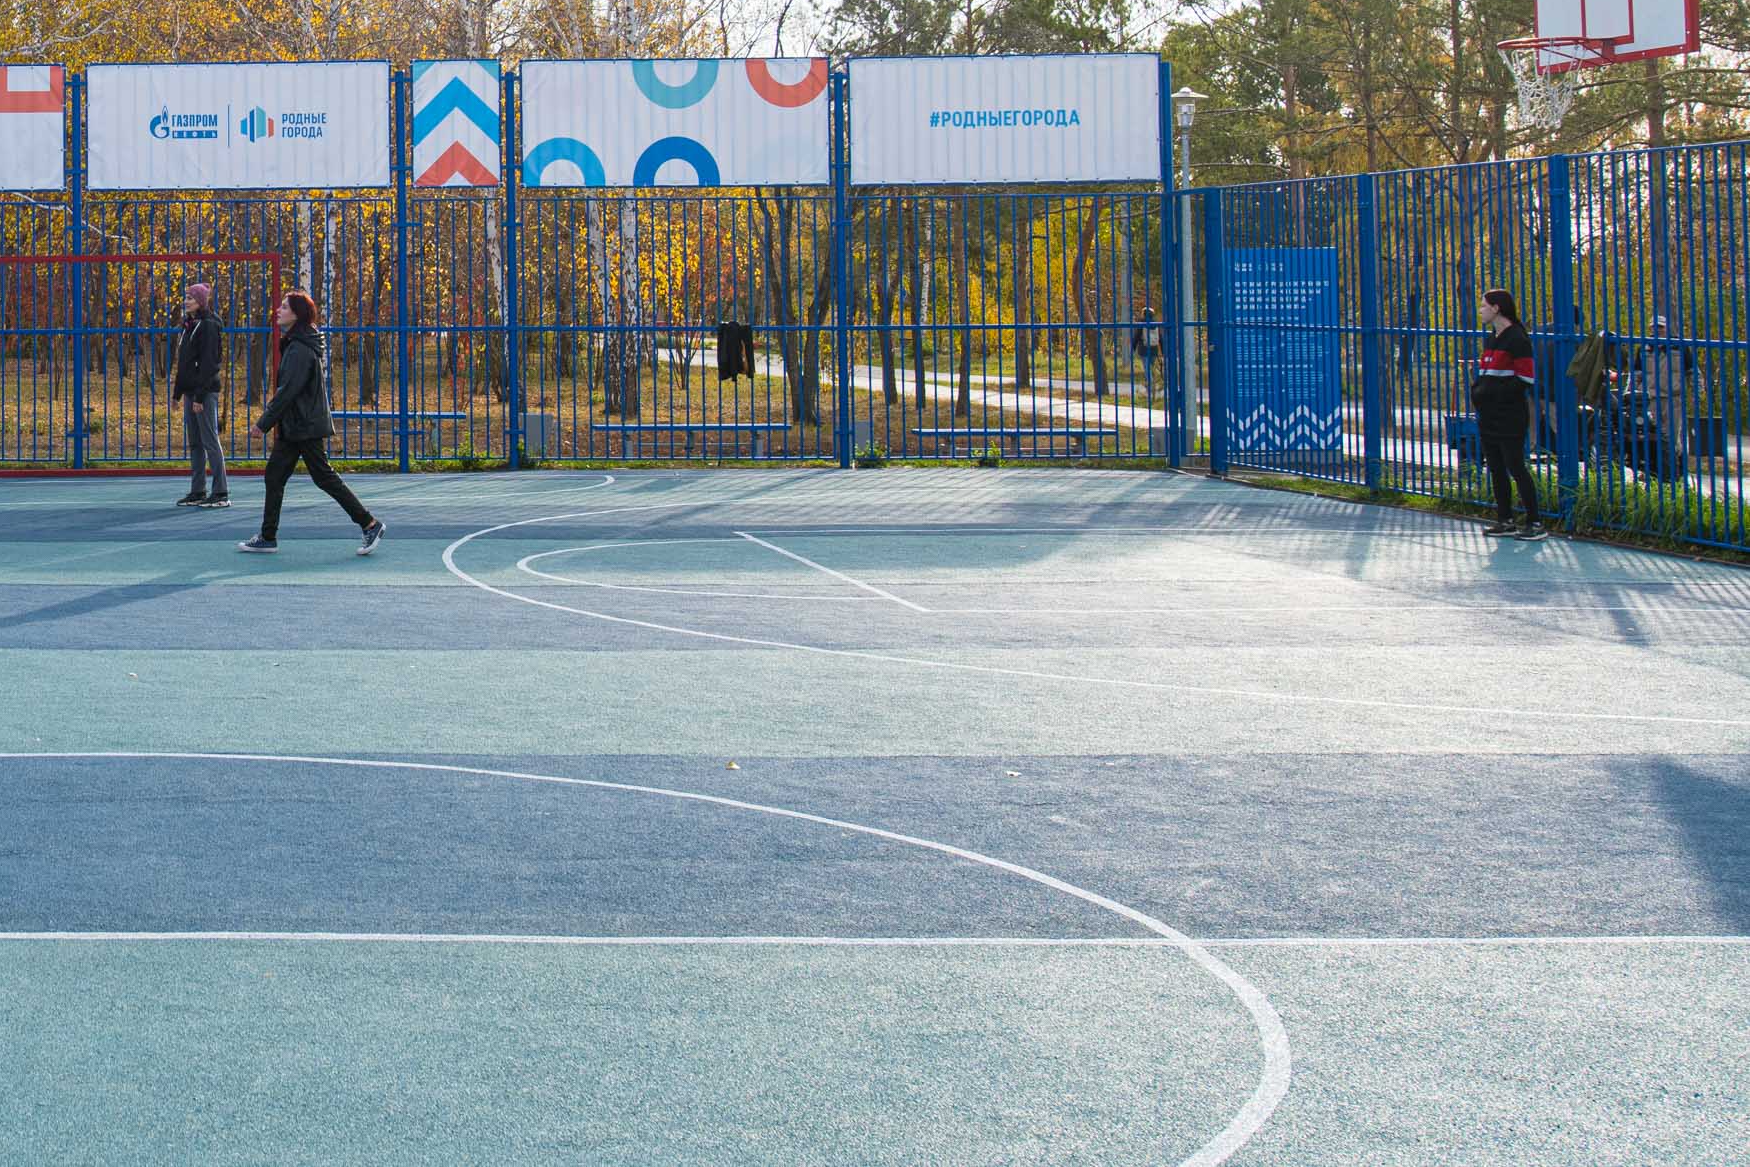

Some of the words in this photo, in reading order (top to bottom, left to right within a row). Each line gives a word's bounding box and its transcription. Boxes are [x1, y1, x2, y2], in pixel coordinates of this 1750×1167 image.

[171, 114, 218, 127] ГАЗПРОМ
[281, 113, 327, 125] РОДНЫЕ
[930, 109, 1081, 129] #РОДНЫЕГОРОДА
[281, 126, 323, 139] ГОРОДА
